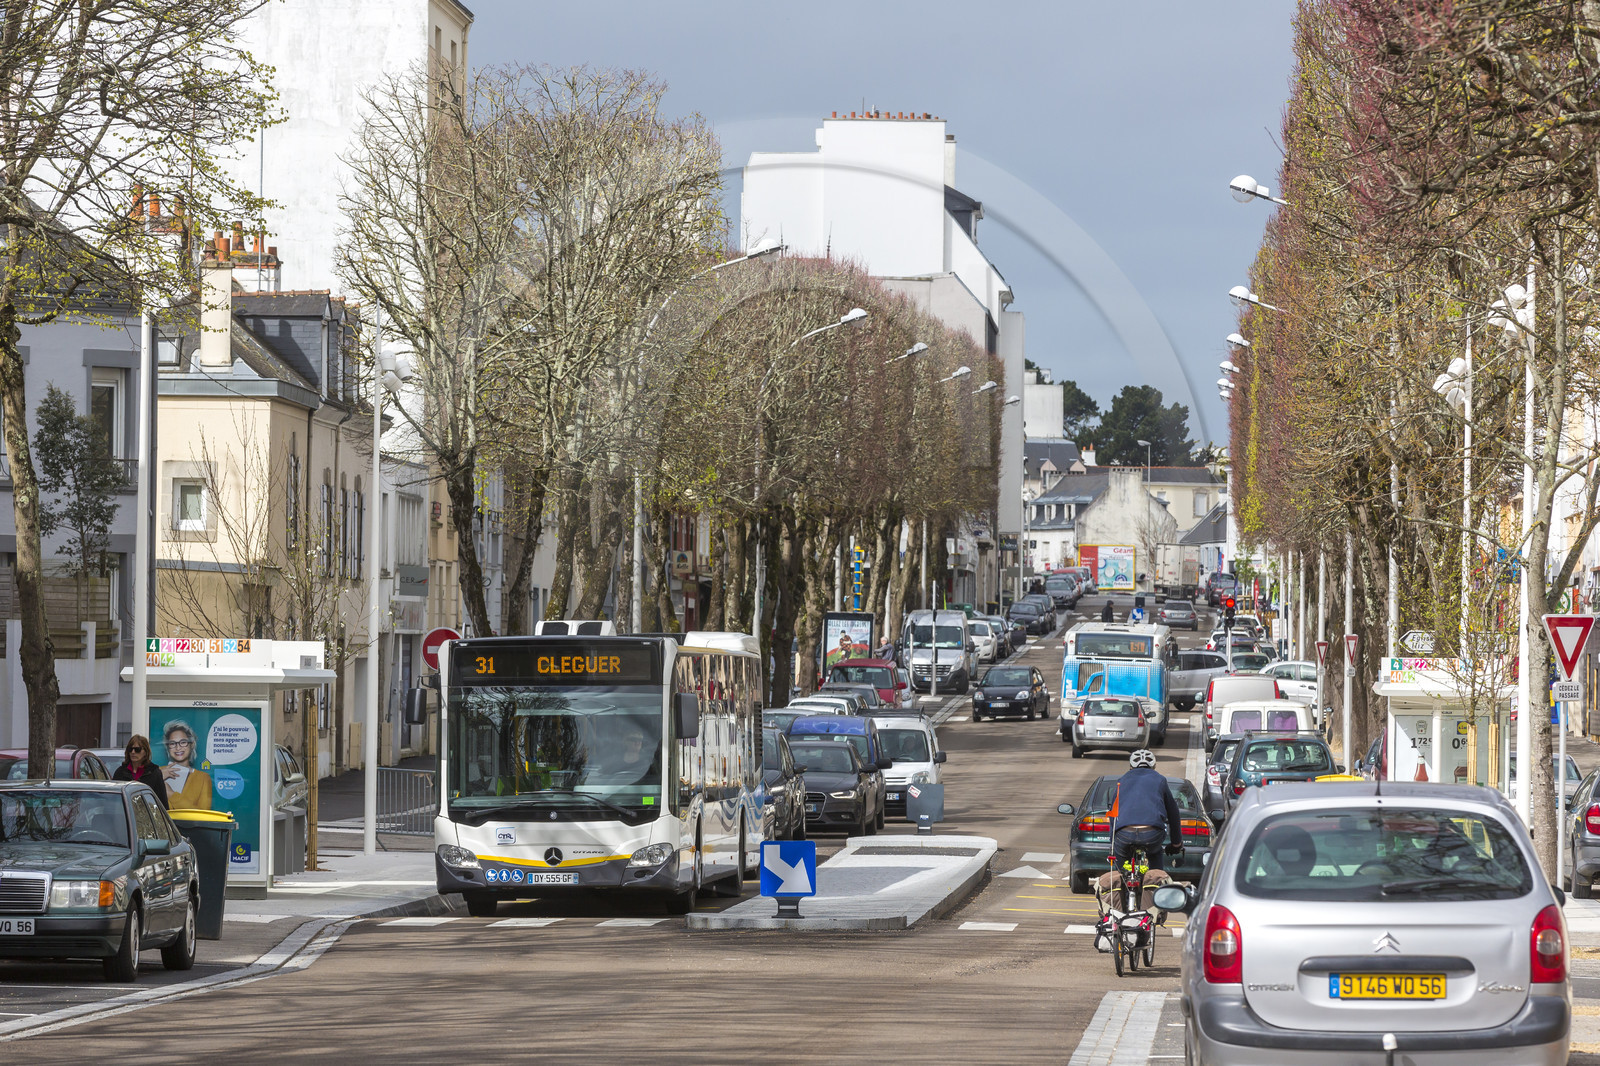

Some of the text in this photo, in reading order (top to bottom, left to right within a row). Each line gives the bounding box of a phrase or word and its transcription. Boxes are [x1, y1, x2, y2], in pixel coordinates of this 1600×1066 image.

[149, 639, 250, 652] 4 21 22 30 51 52 54
[147, 653, 174, 666] 40 42
[475, 656, 621, 674] 31 CLEGUER
[1393, 659, 1400, 670] 4
[1415, 659, 1427, 671] 22
[1391, 671, 1415, 683] 40 42
[534, 874, 572, 883] DY-555-GF
[17, 921, 32, 933] 56
[1342, 976, 1387, 995] 9146
[1393, 976, 1415, 995] WQ
[1419, 977, 1442, 995] 56
